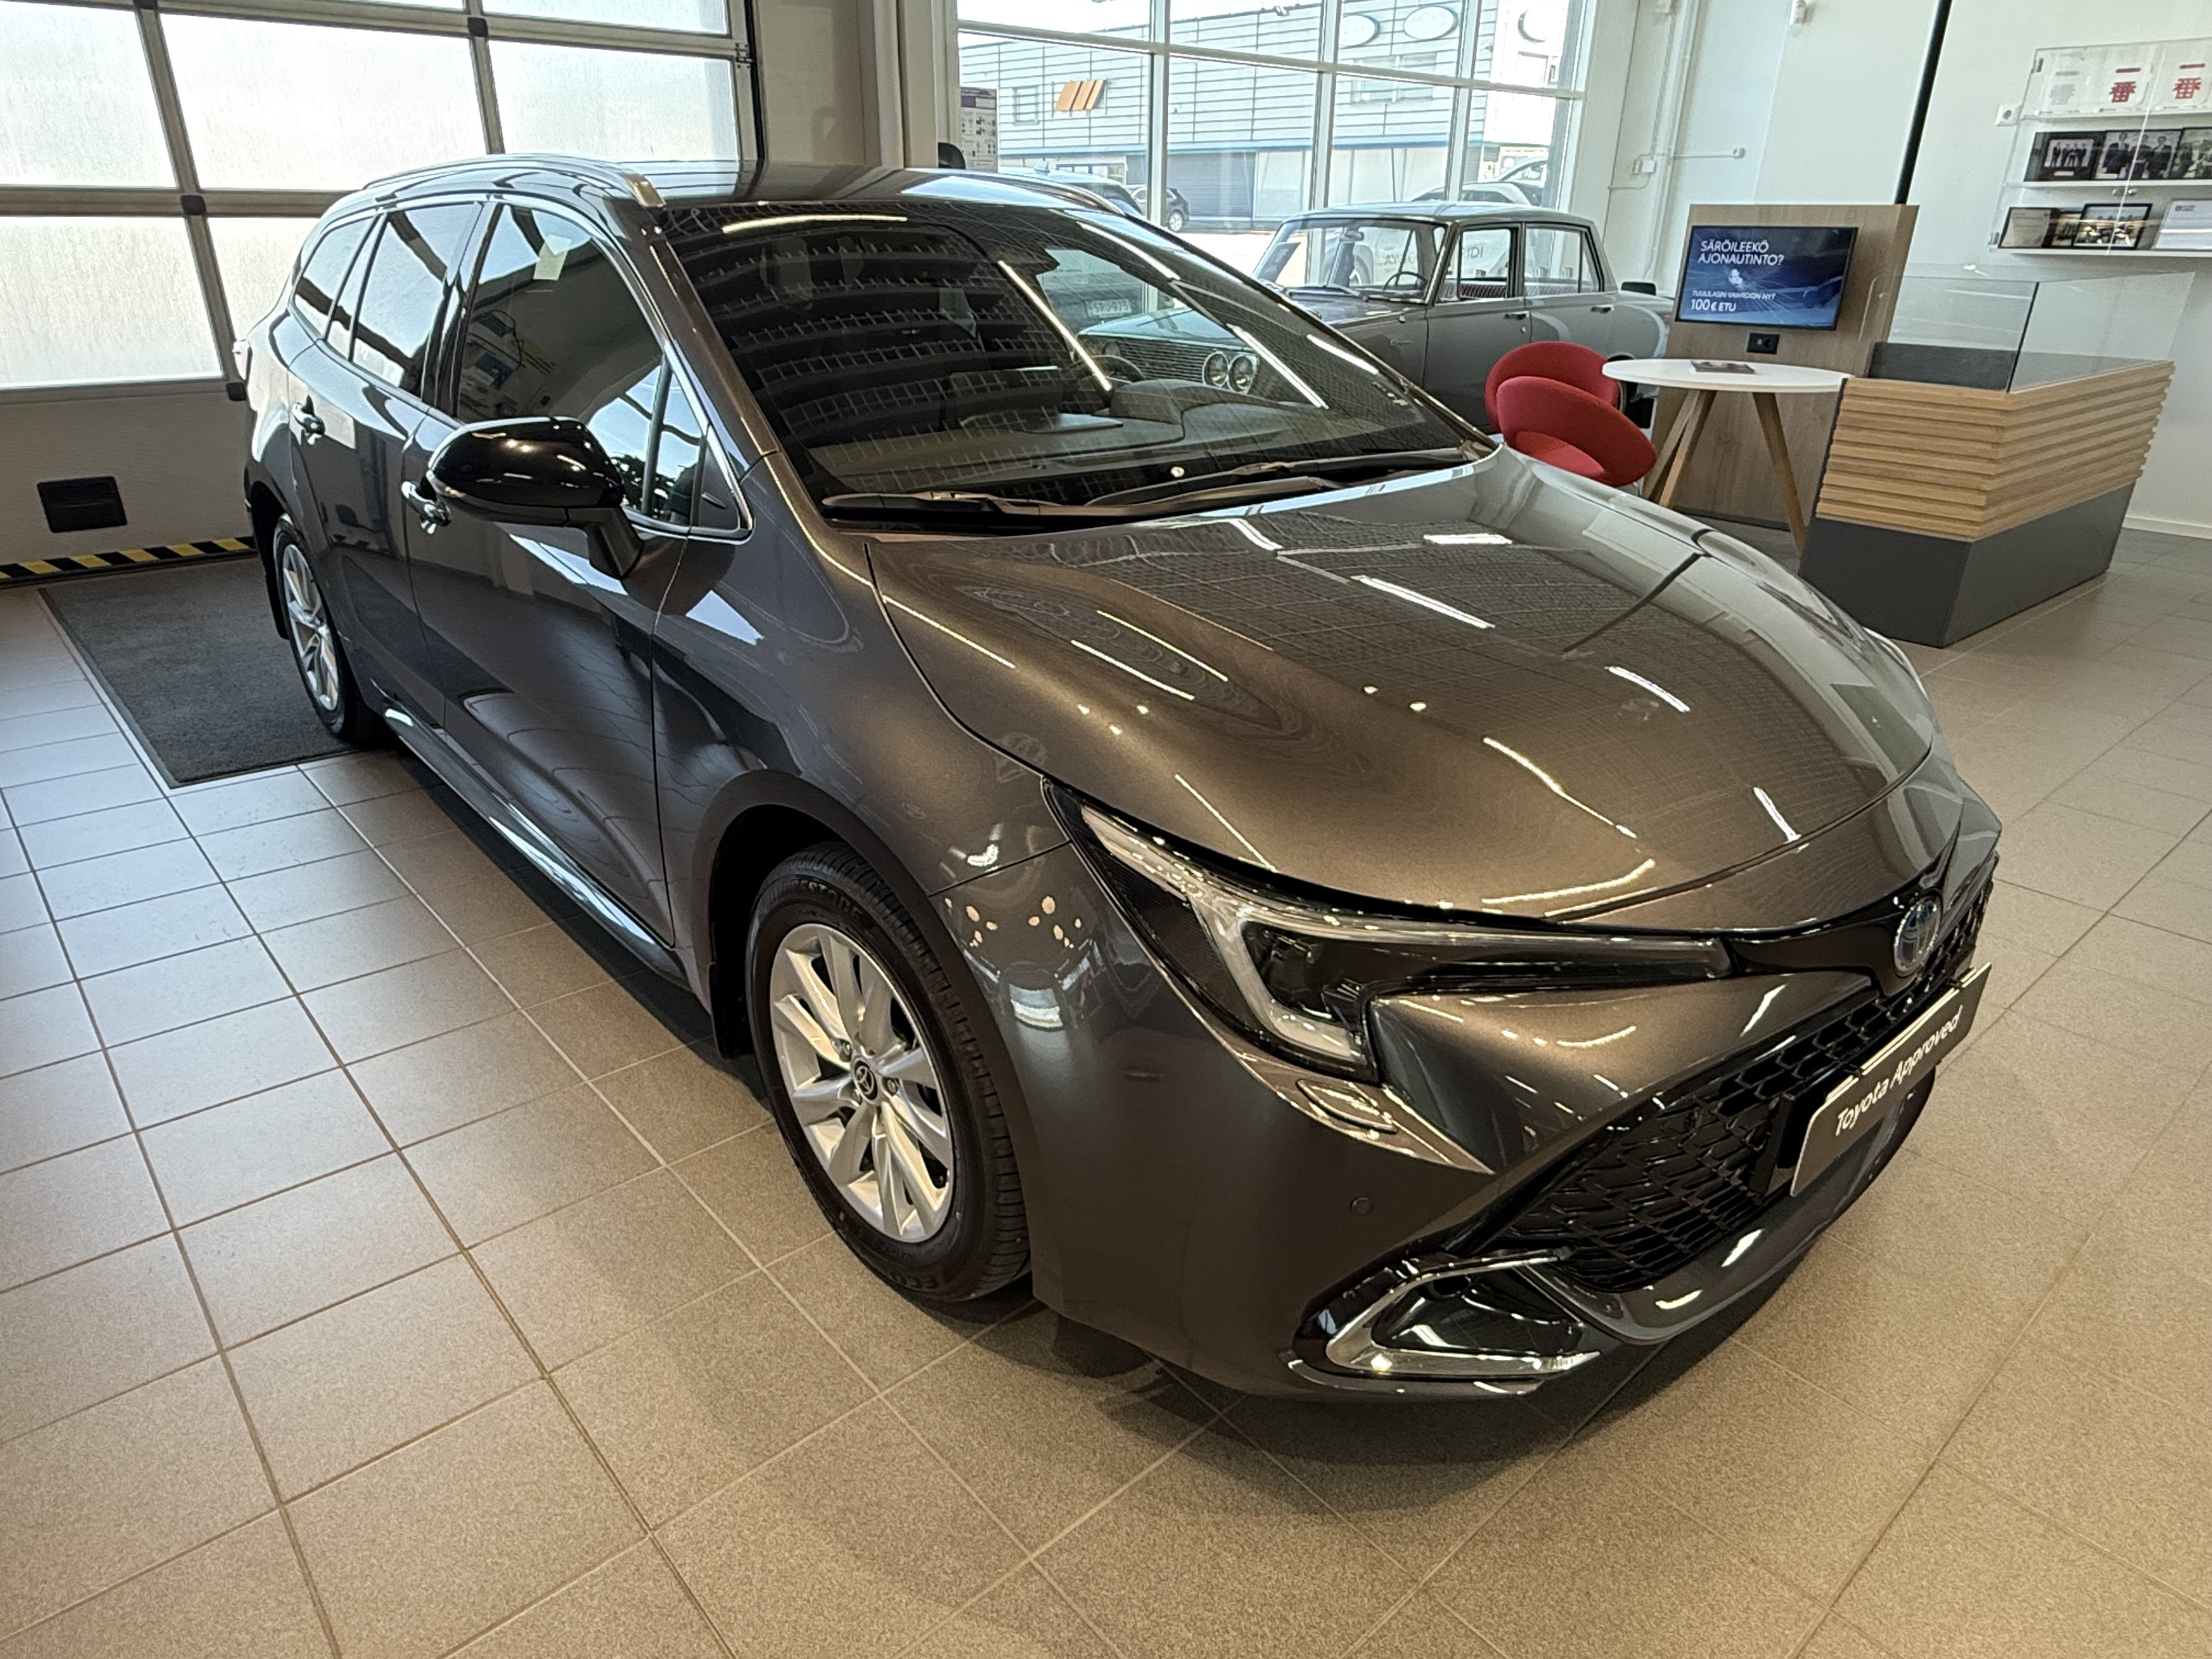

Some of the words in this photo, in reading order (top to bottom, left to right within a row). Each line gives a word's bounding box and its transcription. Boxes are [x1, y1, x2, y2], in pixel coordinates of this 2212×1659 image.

[1700, 239, 1769, 253] SÄRÖILEEKÖ
[1698, 253, 1785, 266] AJONAUTINTO?
[1691, 298, 1711, 311] 100
[1711, 301, 1717, 311] €
[1718, 302, 1736, 312] ETU
[1836, 1077, 1889, 1136] Toyota
[1890, 1004, 1963, 1090] Approved
